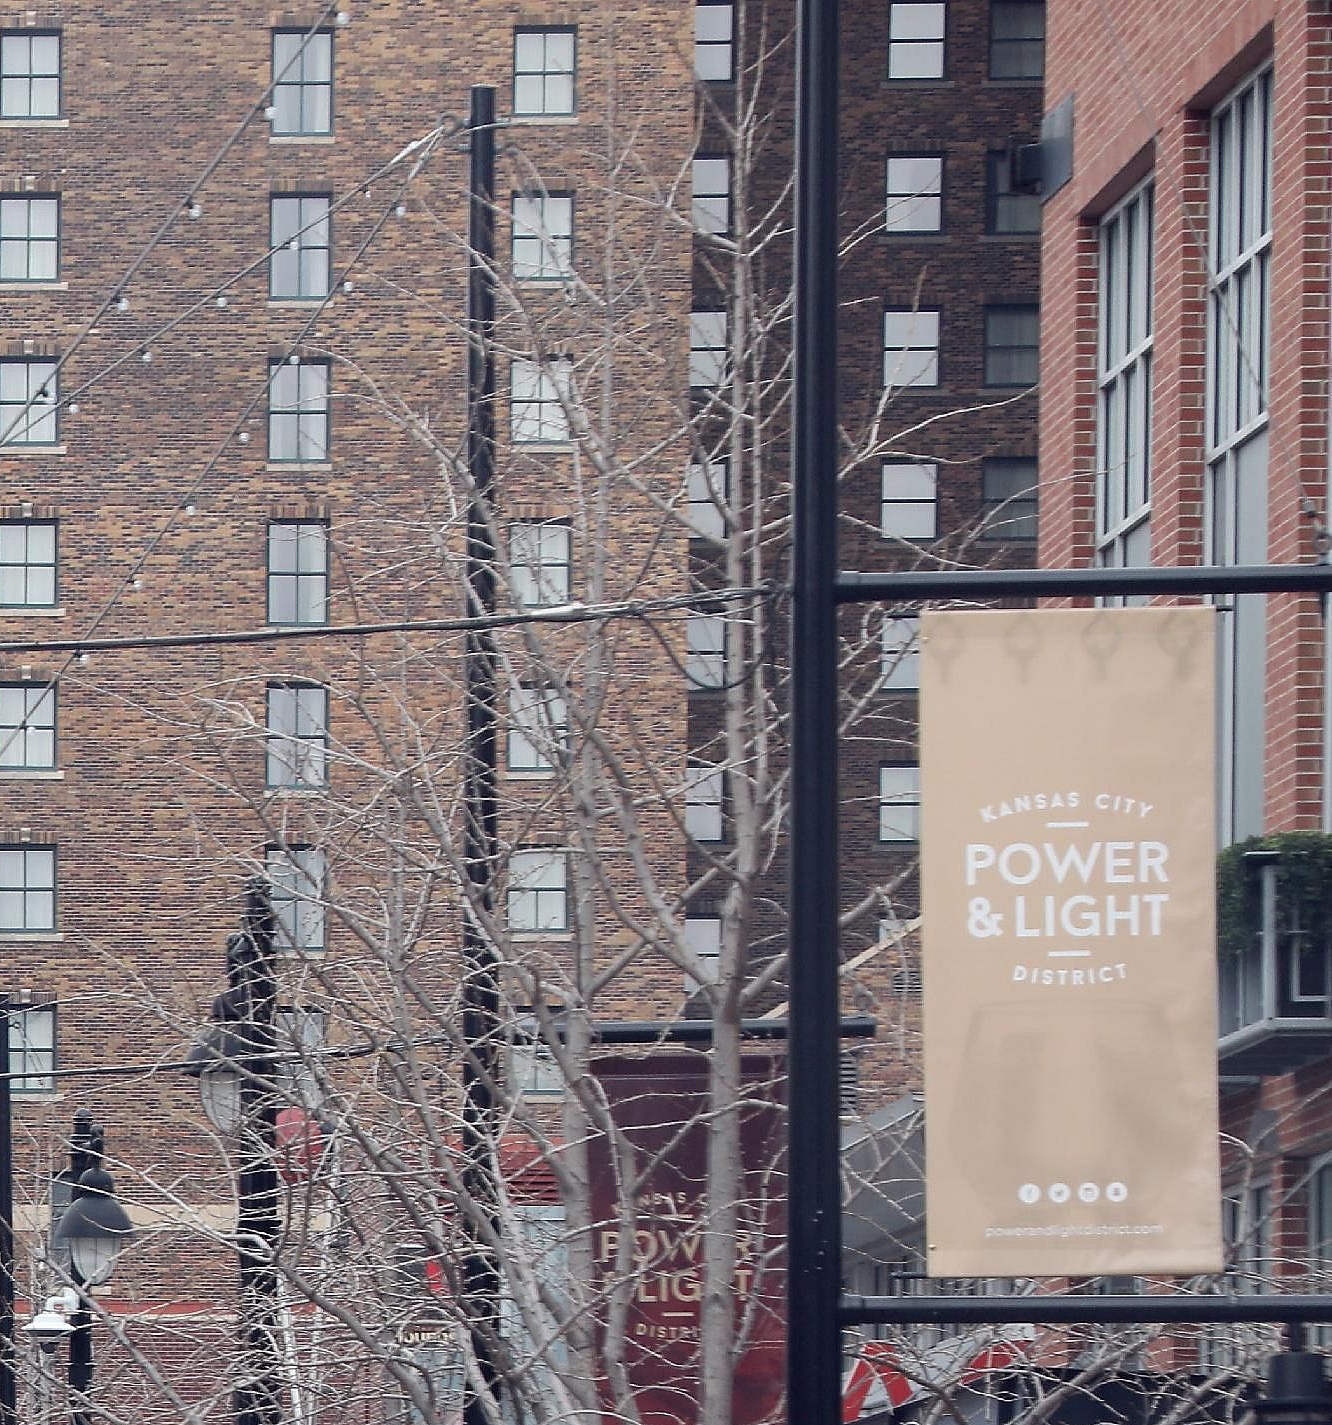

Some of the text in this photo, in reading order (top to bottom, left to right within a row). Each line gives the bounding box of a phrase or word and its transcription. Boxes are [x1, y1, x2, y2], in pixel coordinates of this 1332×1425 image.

[980, 792, 1154, 823] KANSAS CITY
[965, 841, 1170, 886] POWER
[967, 893, 1170, 938] & LIGHT
[1012, 963, 1127, 985] DISTRICT
[601, 1230, 756, 1263] POWR
[638, 1269, 753, 1302] LIGT
